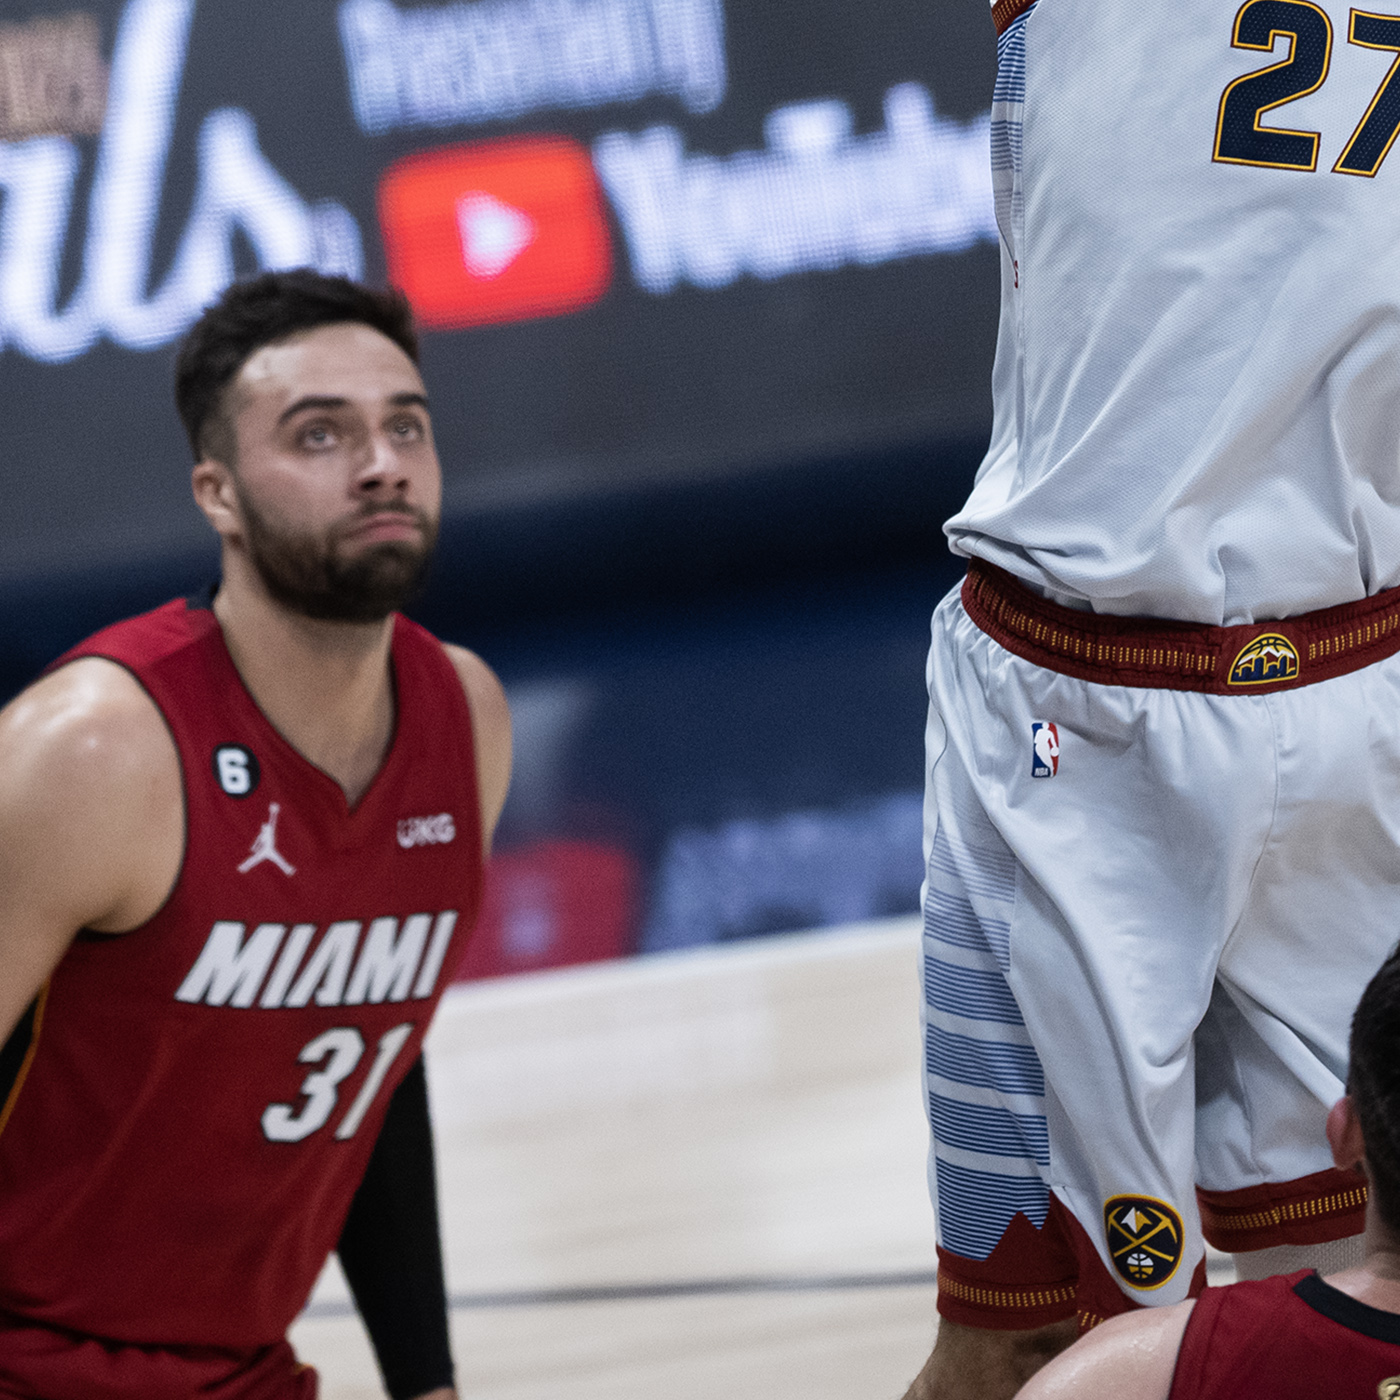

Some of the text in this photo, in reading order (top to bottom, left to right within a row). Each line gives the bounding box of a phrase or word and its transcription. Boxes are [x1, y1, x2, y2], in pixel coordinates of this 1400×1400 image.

[216, 747, 252, 795] 6
[174, 909, 459, 1009] MIAMI
[260, 1022, 415, 1144] 31
